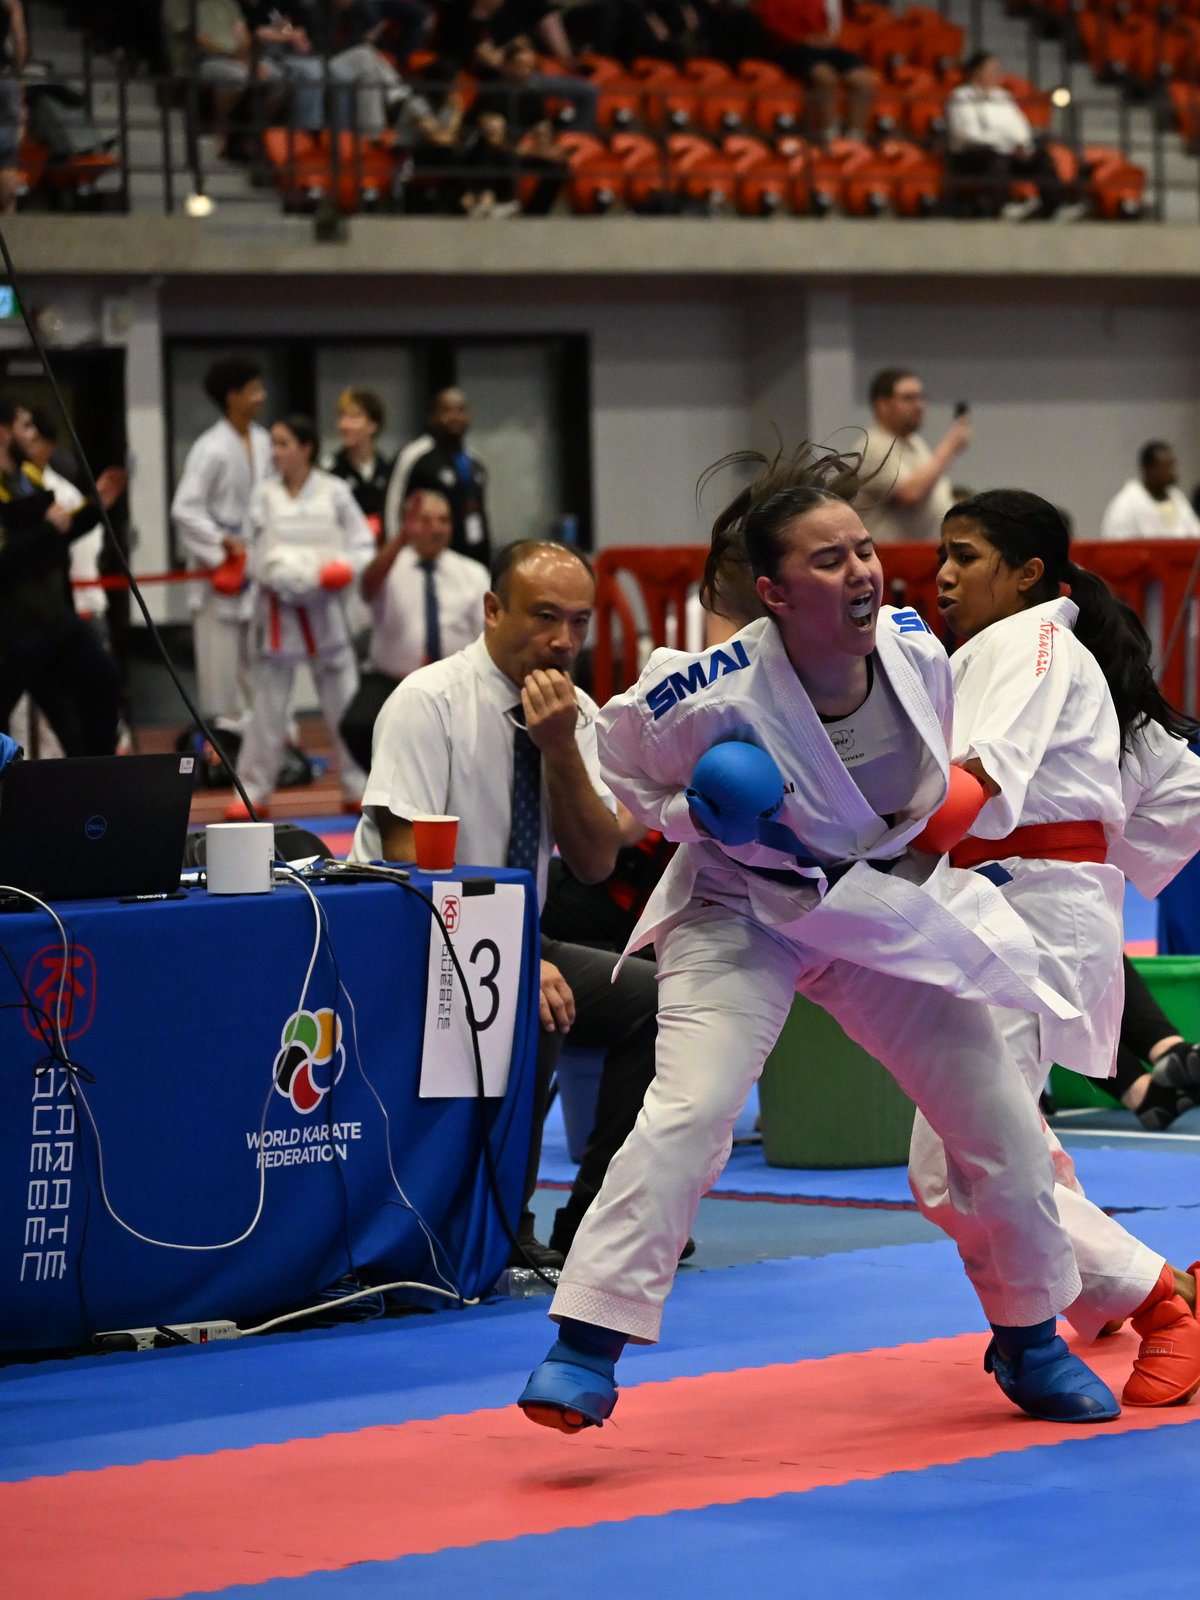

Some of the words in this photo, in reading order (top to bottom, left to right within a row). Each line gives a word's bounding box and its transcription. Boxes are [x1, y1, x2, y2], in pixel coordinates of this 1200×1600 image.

[891, 611, 932, 635] S
[645, 640, 751, 721] SMAI
[465, 938, 501, 1032] 3
[246, 1128, 300, 1149] WORLD
[302, 1122, 362, 1143] KARATE
[256, 1144, 347, 1168] FEDERATION
